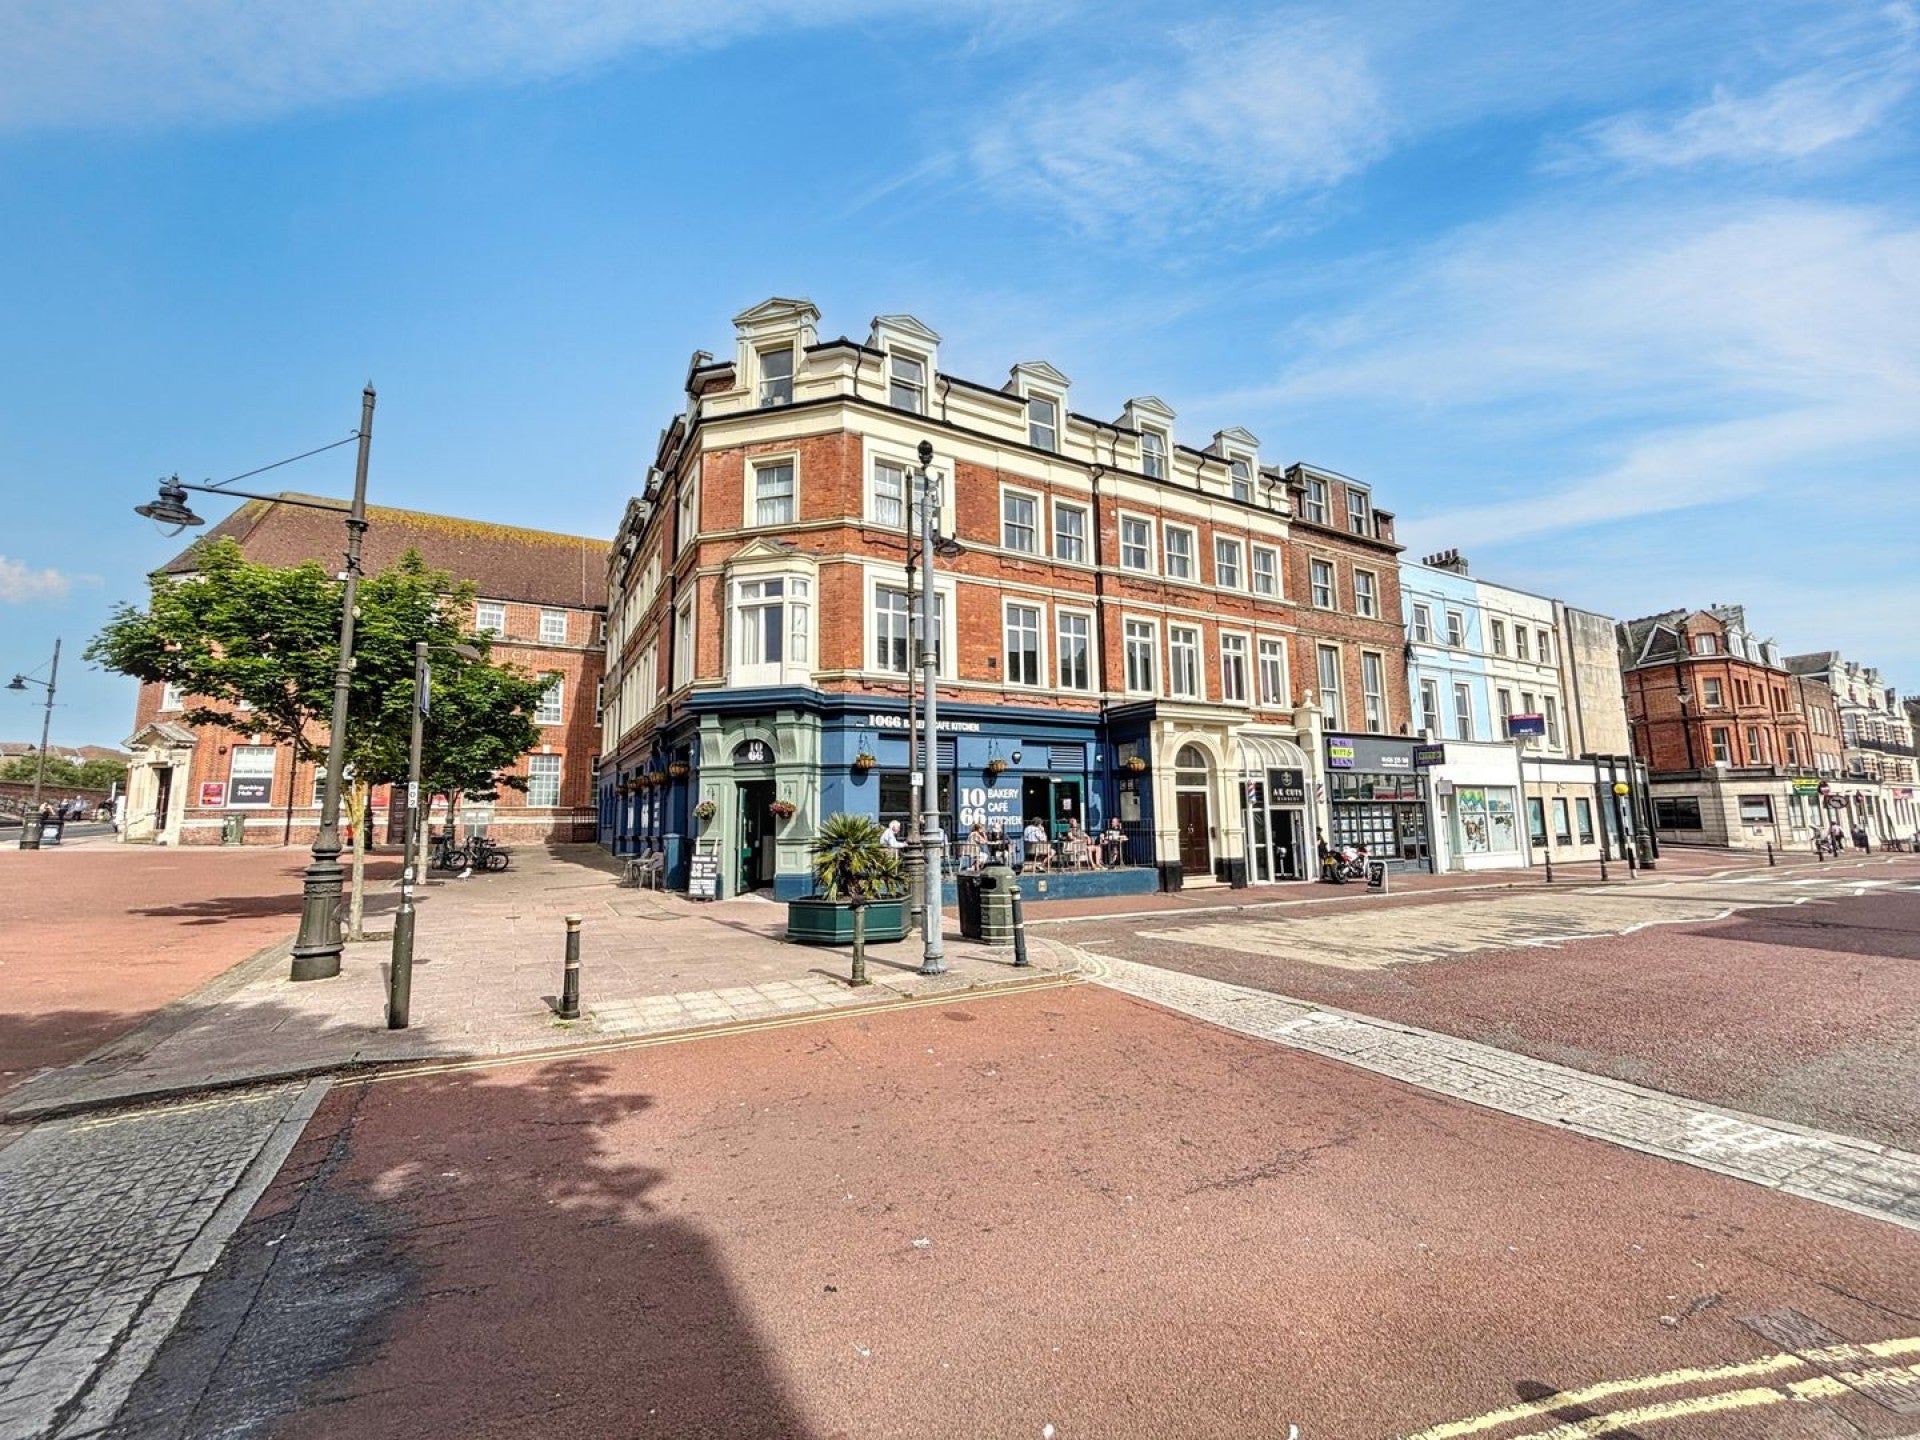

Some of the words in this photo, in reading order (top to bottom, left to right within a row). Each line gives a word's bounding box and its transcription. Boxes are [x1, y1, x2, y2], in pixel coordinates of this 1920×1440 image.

[868, 714, 901, 728] 1066
[951, 722, 980, 732] KITCHEN
[750, 741, 764, 752] 10
[748, 751, 764, 761] 66
[960, 788, 986, 807] 10
[987, 788, 1019, 799] BAKERY
[960, 807, 986, 826] 66
[987, 815, 1022, 826] KITCHEN
